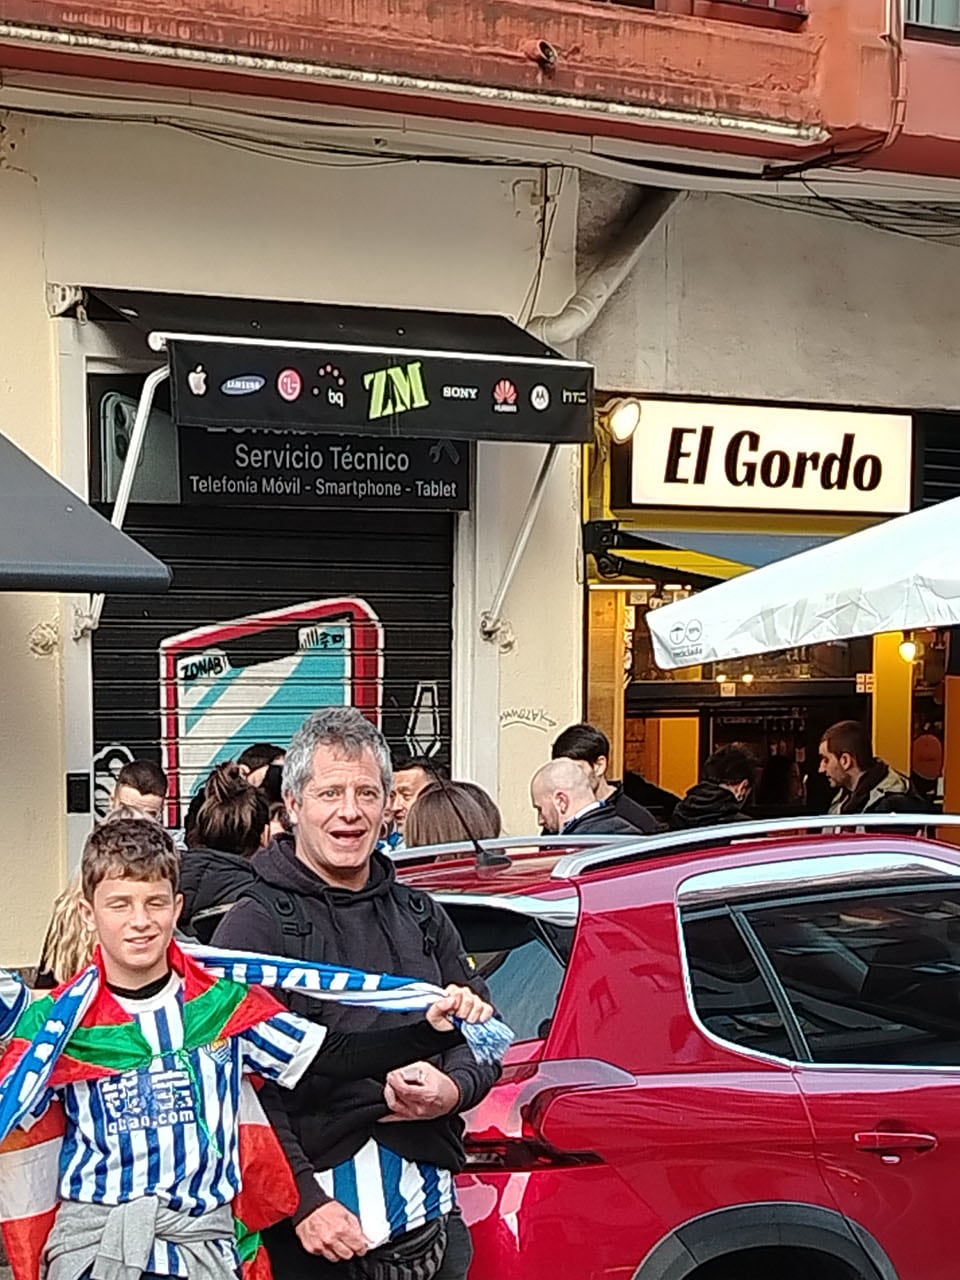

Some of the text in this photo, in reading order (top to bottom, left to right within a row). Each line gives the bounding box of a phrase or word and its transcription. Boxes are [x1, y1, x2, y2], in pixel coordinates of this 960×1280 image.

[328, 387, 344, 407] bq
[363, 361, 430, 420] ZM
[442, 386, 478, 399] SONY
[235, 443, 410, 471] Servicio Técnico
[663, 425, 882, 491] El Gordo
[190, 475, 258, 494] Telefonía
[262, 476, 301, 495] Móvil
[315, 478, 402, 499] Smartphone
[415, 480, 457, 497] Tablet
